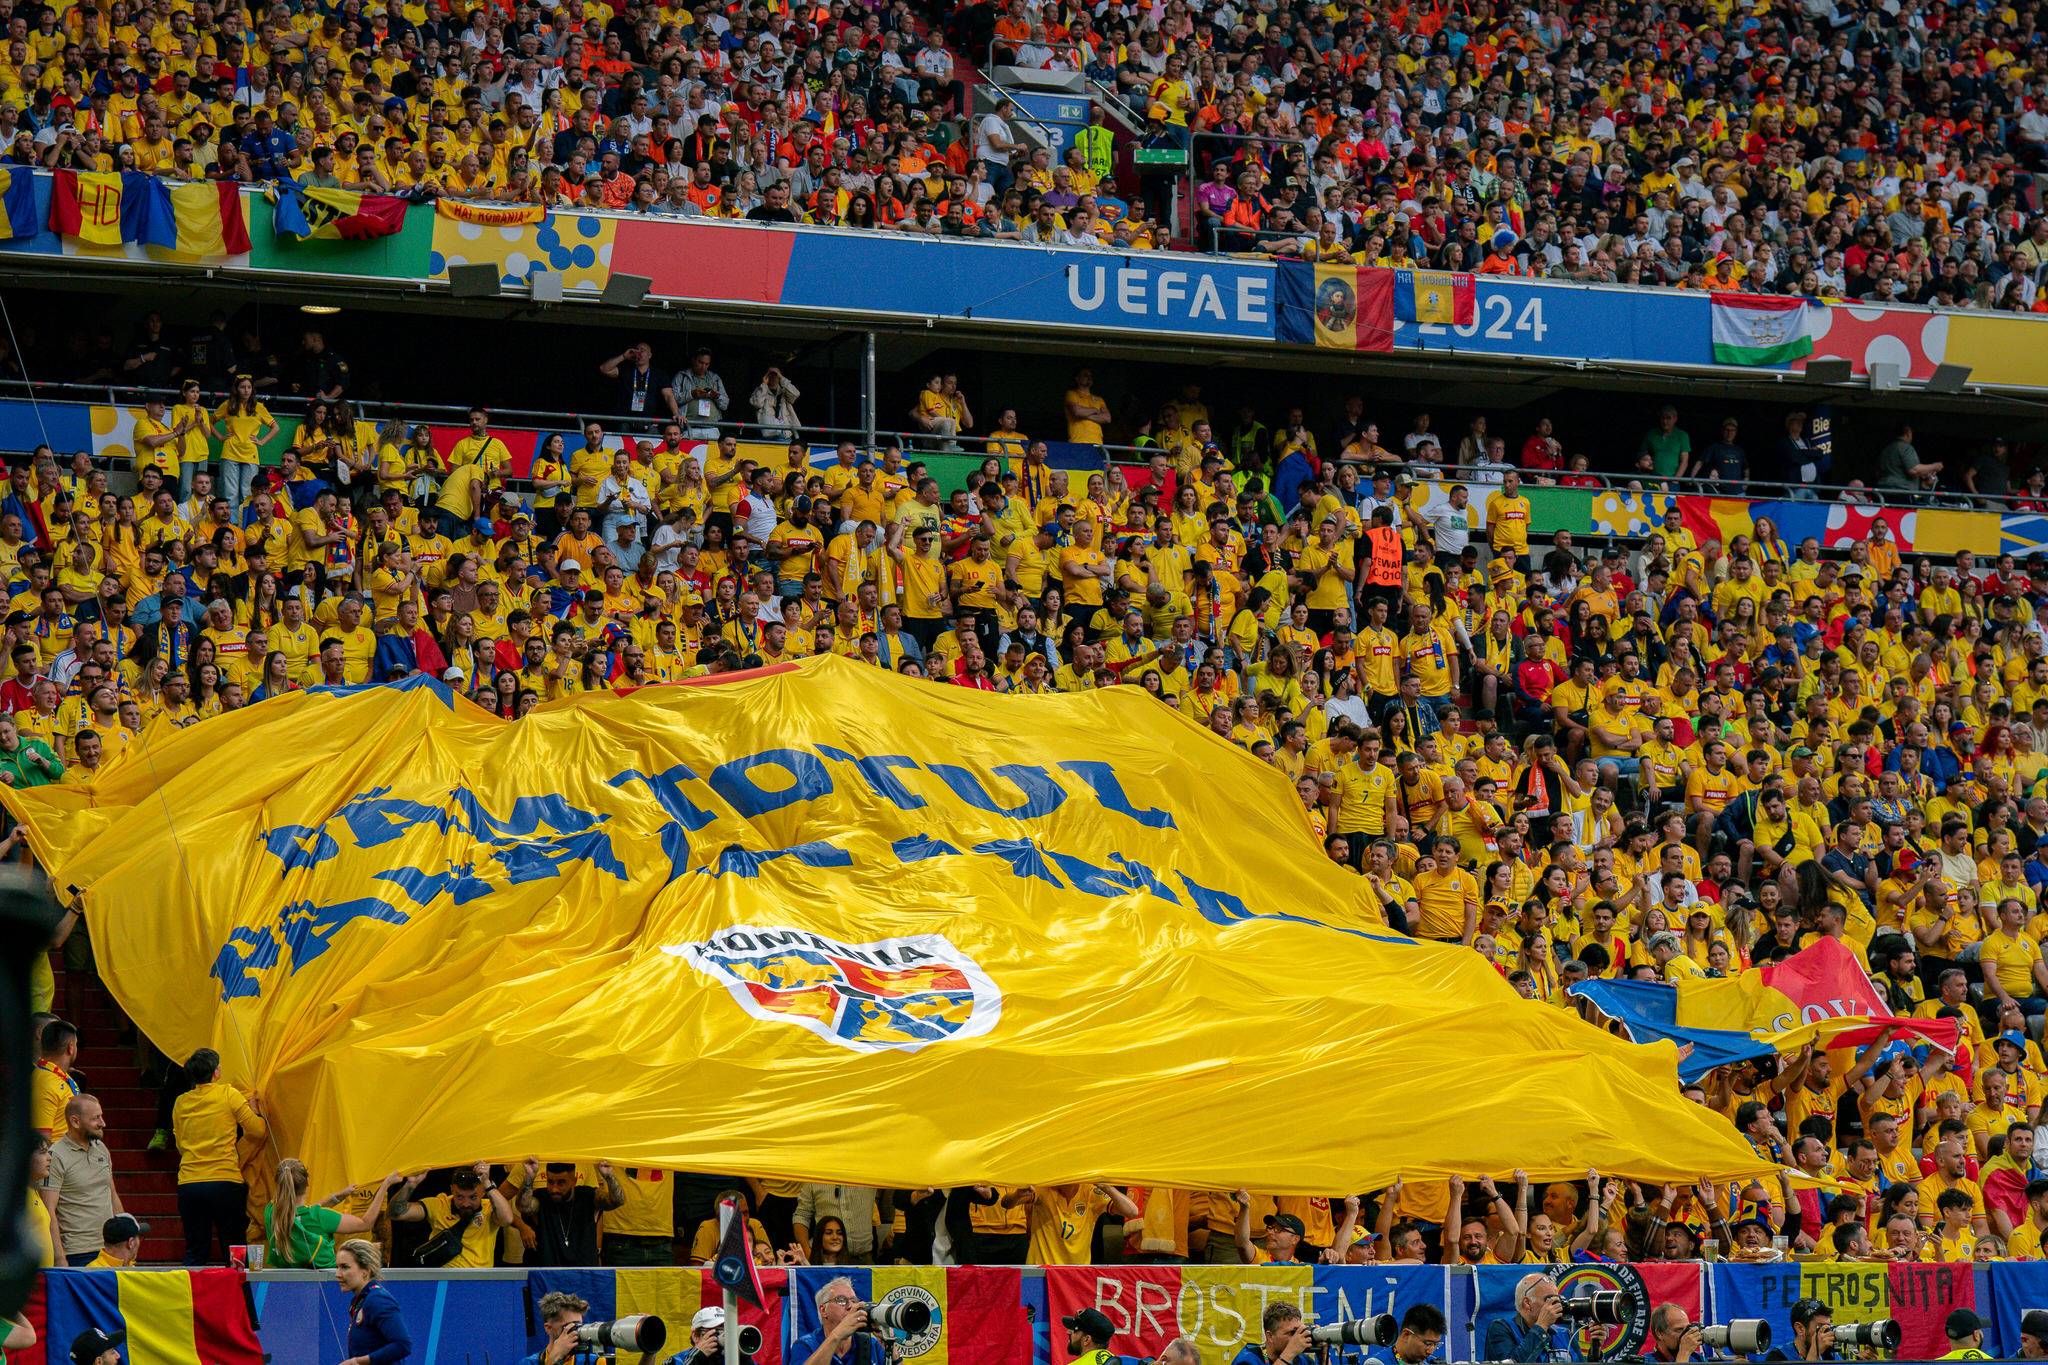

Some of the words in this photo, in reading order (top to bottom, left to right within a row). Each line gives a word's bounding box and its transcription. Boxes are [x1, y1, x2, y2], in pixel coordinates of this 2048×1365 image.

[454, 204, 473, 219] HAI
[967, 571, 979, 580] 10
[563, 677, 574, 691] 18
[1655, 764, 1674, 773] PENNY
[604, 743, 1179, 832] TOTUL
[1706, 790, 1727, 798] PENNY
[1362, 790, 1369, 803] 7
[1618, 1266, 1635, 1284] DE
[887, 1288, 932, 1306] CORVINUL
[896, 1326, 940, 1356] NEDOARA
